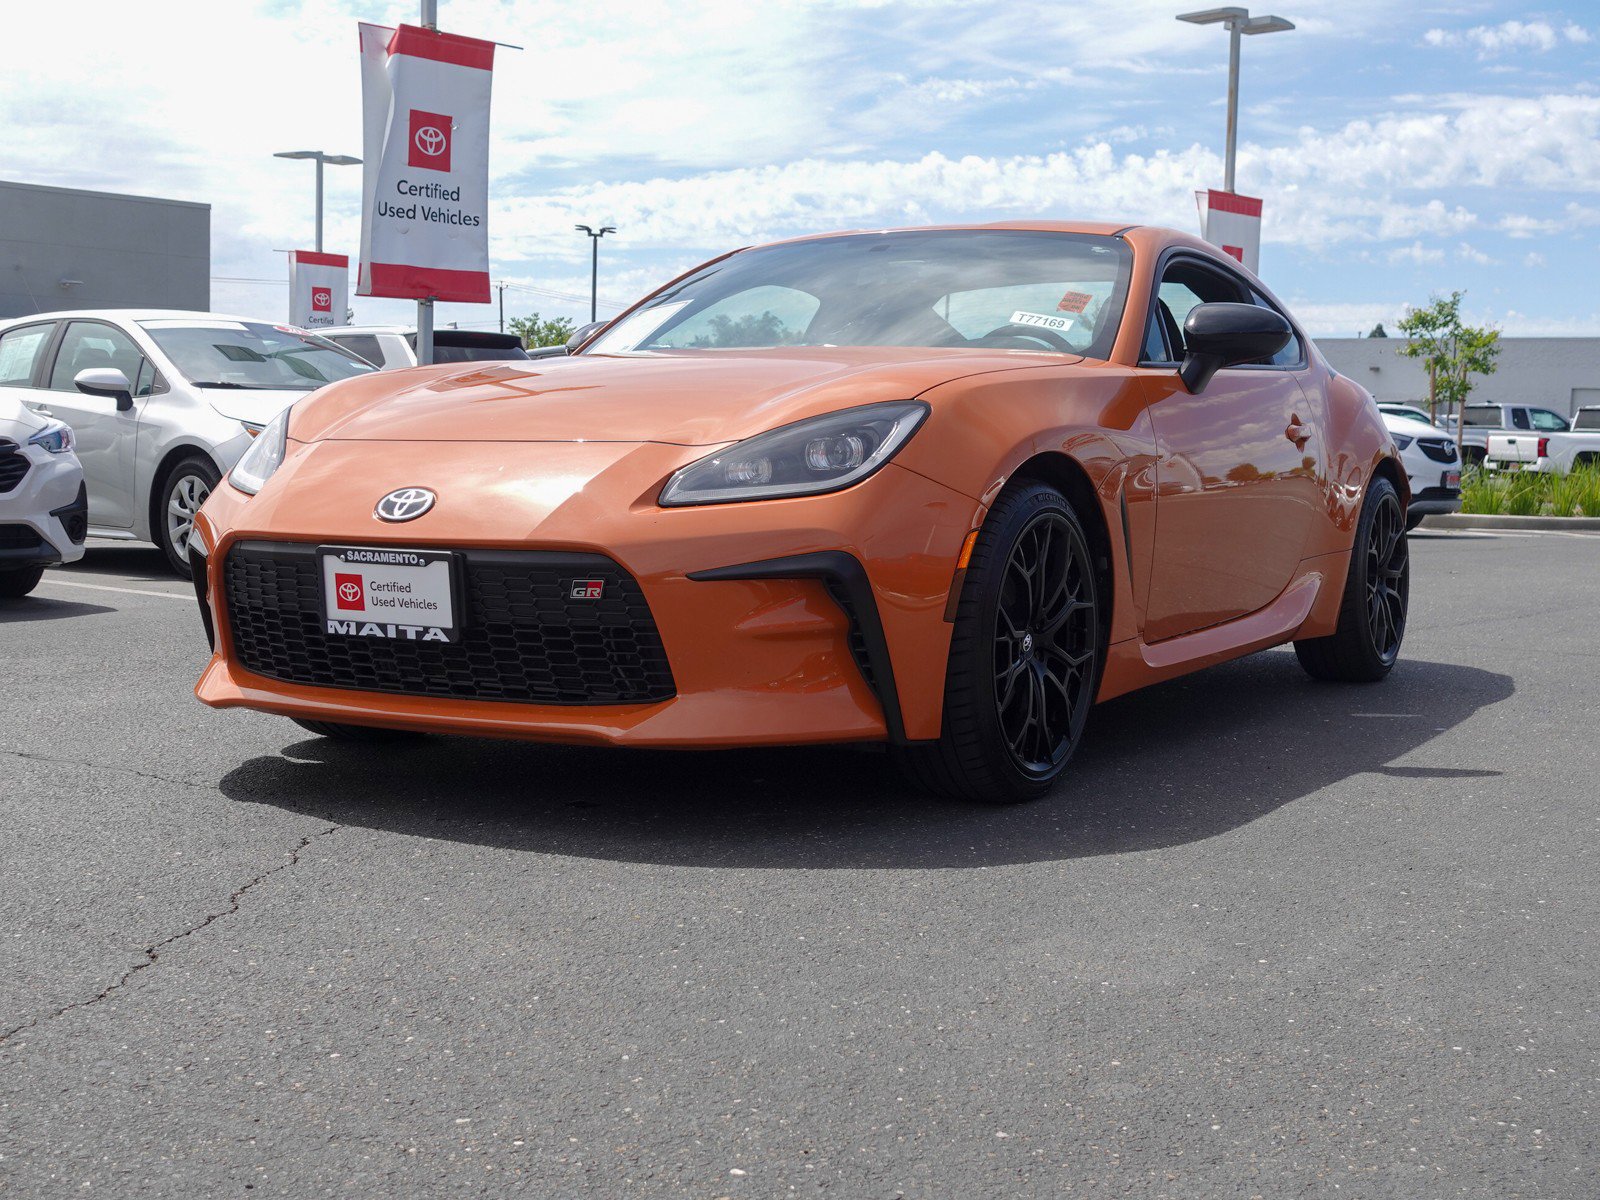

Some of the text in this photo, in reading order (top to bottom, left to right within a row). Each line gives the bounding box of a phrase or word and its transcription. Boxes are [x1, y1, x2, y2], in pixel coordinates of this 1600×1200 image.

[397, 180, 460, 201] Certified
[378, 201, 480, 227] Used Vehicles
[1019, 314, 1065, 328] T77169
[346, 550, 418, 564] SACRAMENTO
[370, 581, 412, 593] Certified
[573, 588, 600, 596] GR
[371, 596, 438, 610] Used Vehicles
[327, 620, 450, 642] MAITA
